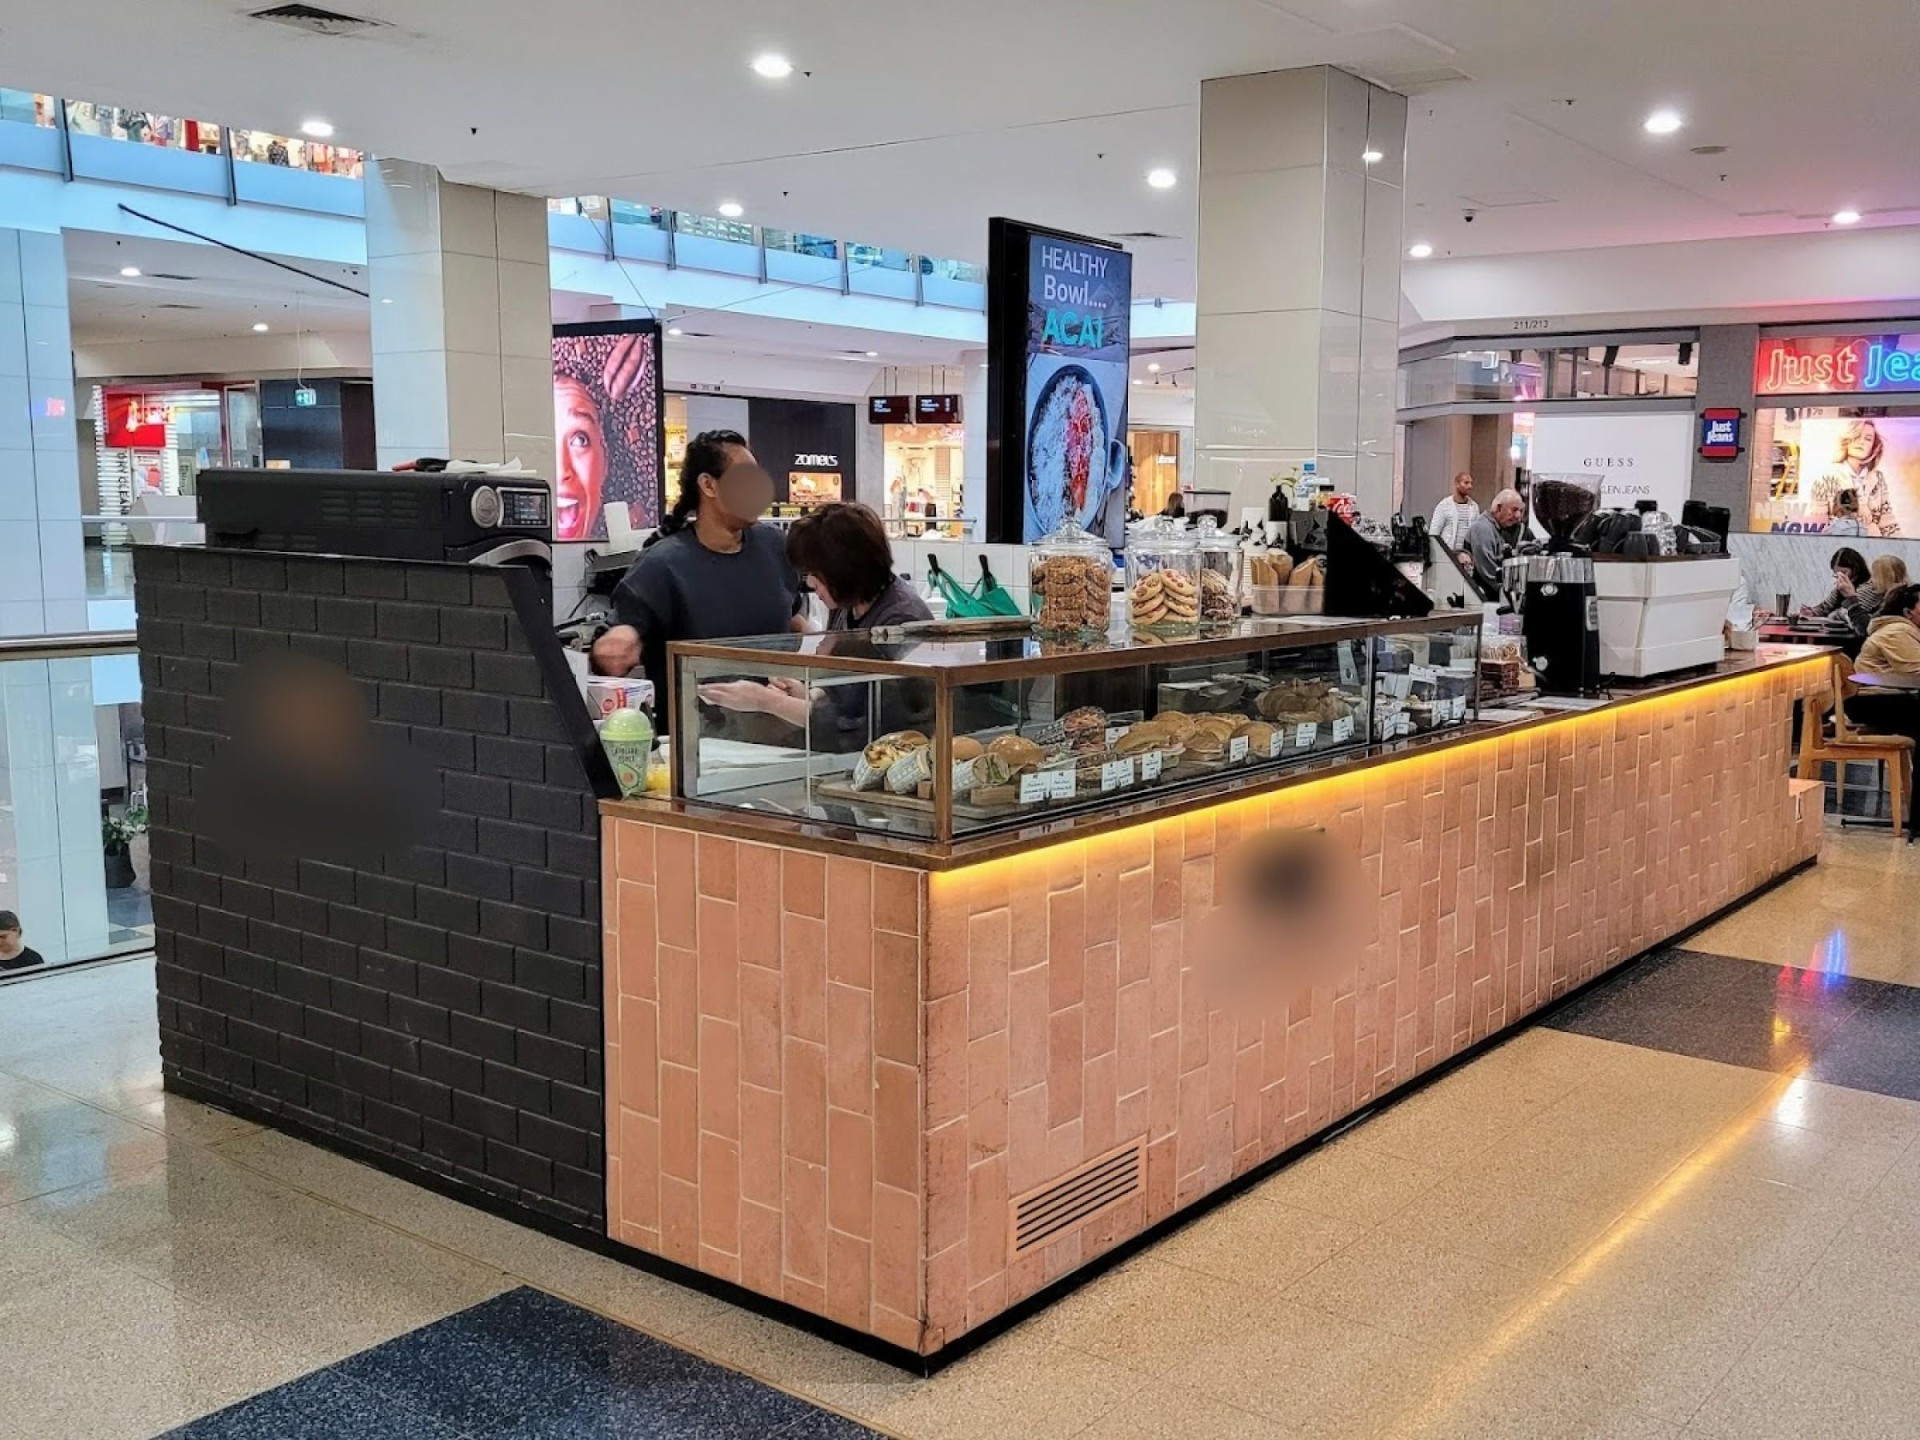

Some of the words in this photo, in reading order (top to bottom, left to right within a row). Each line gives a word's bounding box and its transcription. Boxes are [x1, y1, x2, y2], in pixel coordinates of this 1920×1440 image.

[1042, 245, 1108, 278] HEALTHY
[1041, 308, 1104, 349] ACAI
[1513, 319, 1548, 330] 211/213
[1766, 347, 1858, 391] Just
[1711, 420, 1732, 433] Just
[1706, 431, 1734, 444] Jeans
[1583, 457, 1634, 468] GUESS
[1622, 485, 1650, 495] JEANS
